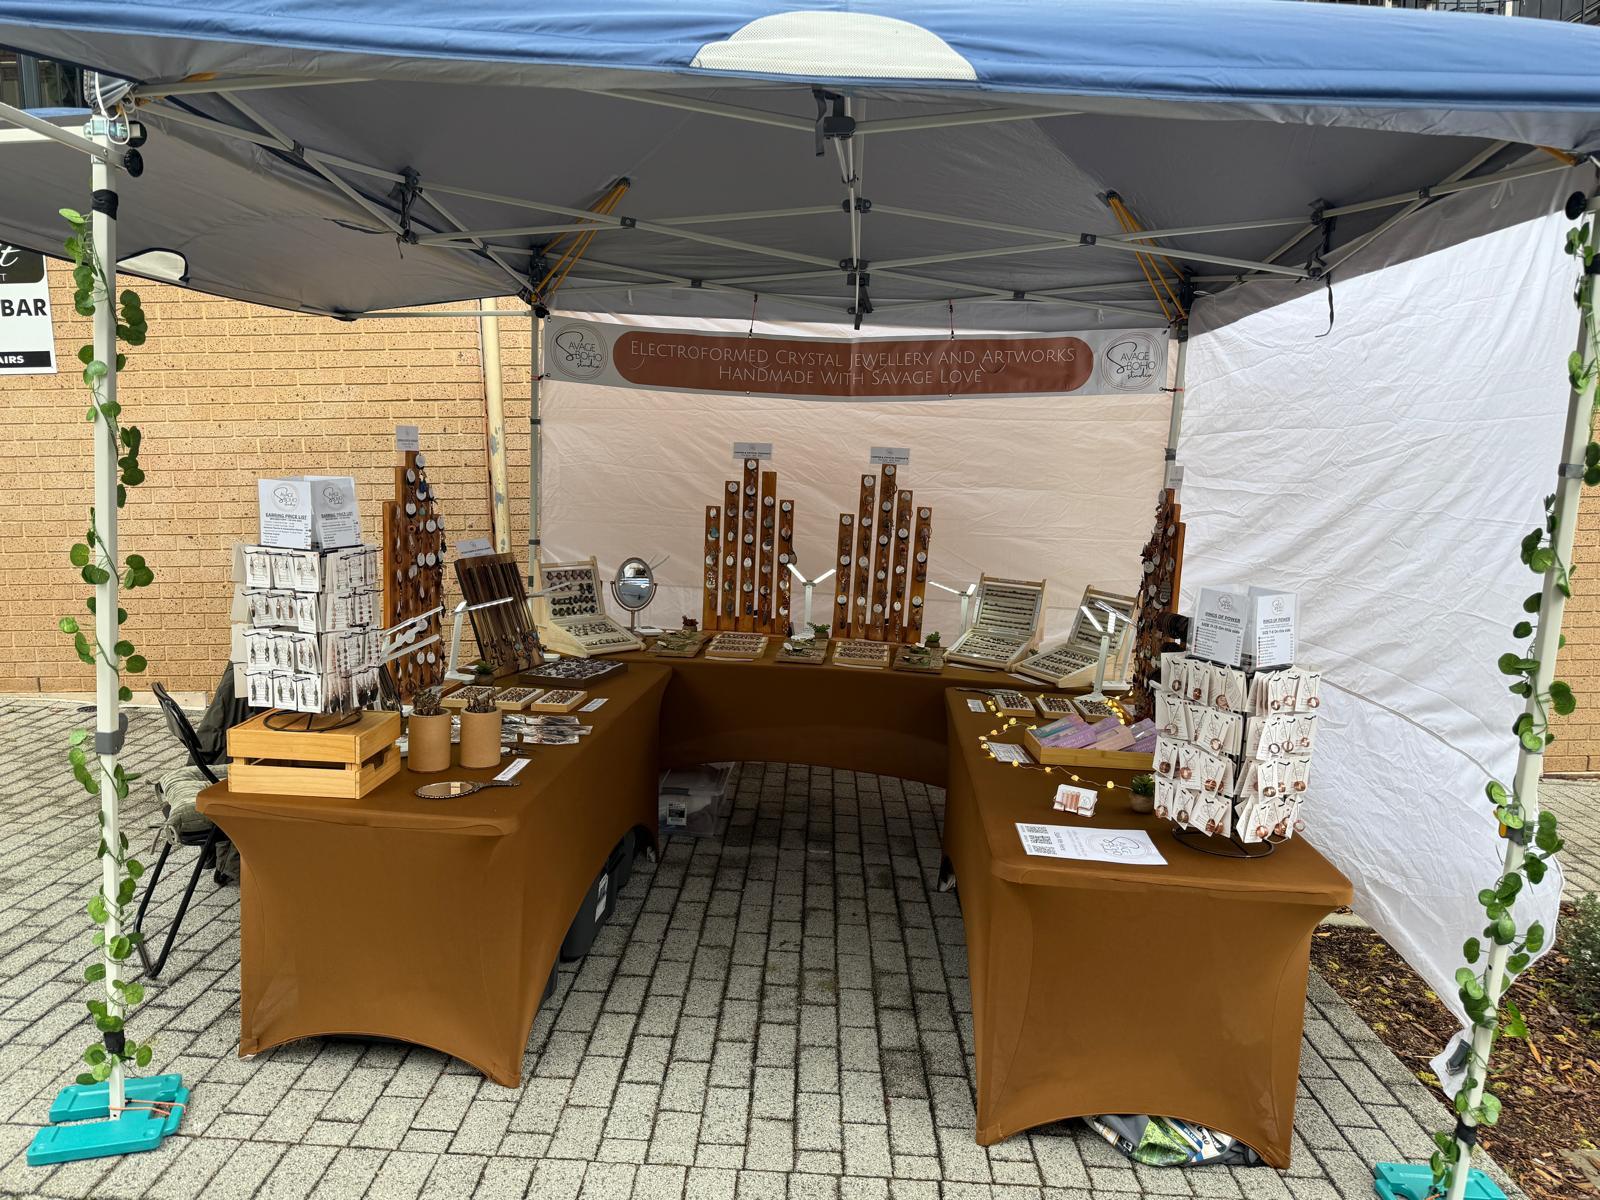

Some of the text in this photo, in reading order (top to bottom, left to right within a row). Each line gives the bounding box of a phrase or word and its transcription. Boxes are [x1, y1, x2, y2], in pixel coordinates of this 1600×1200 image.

[0, 299, 47, 317] BAR
[575, 351, 603, 362] BOHO
[630, 340, 1075, 371] ELECTROFORMED CRYSTAL JEWELLERY AND ARTWORKS
[1125, 361, 1156, 371] BOHO
[719, 366, 982, 385] HANDMADE WITH SAVAGE LOVE
